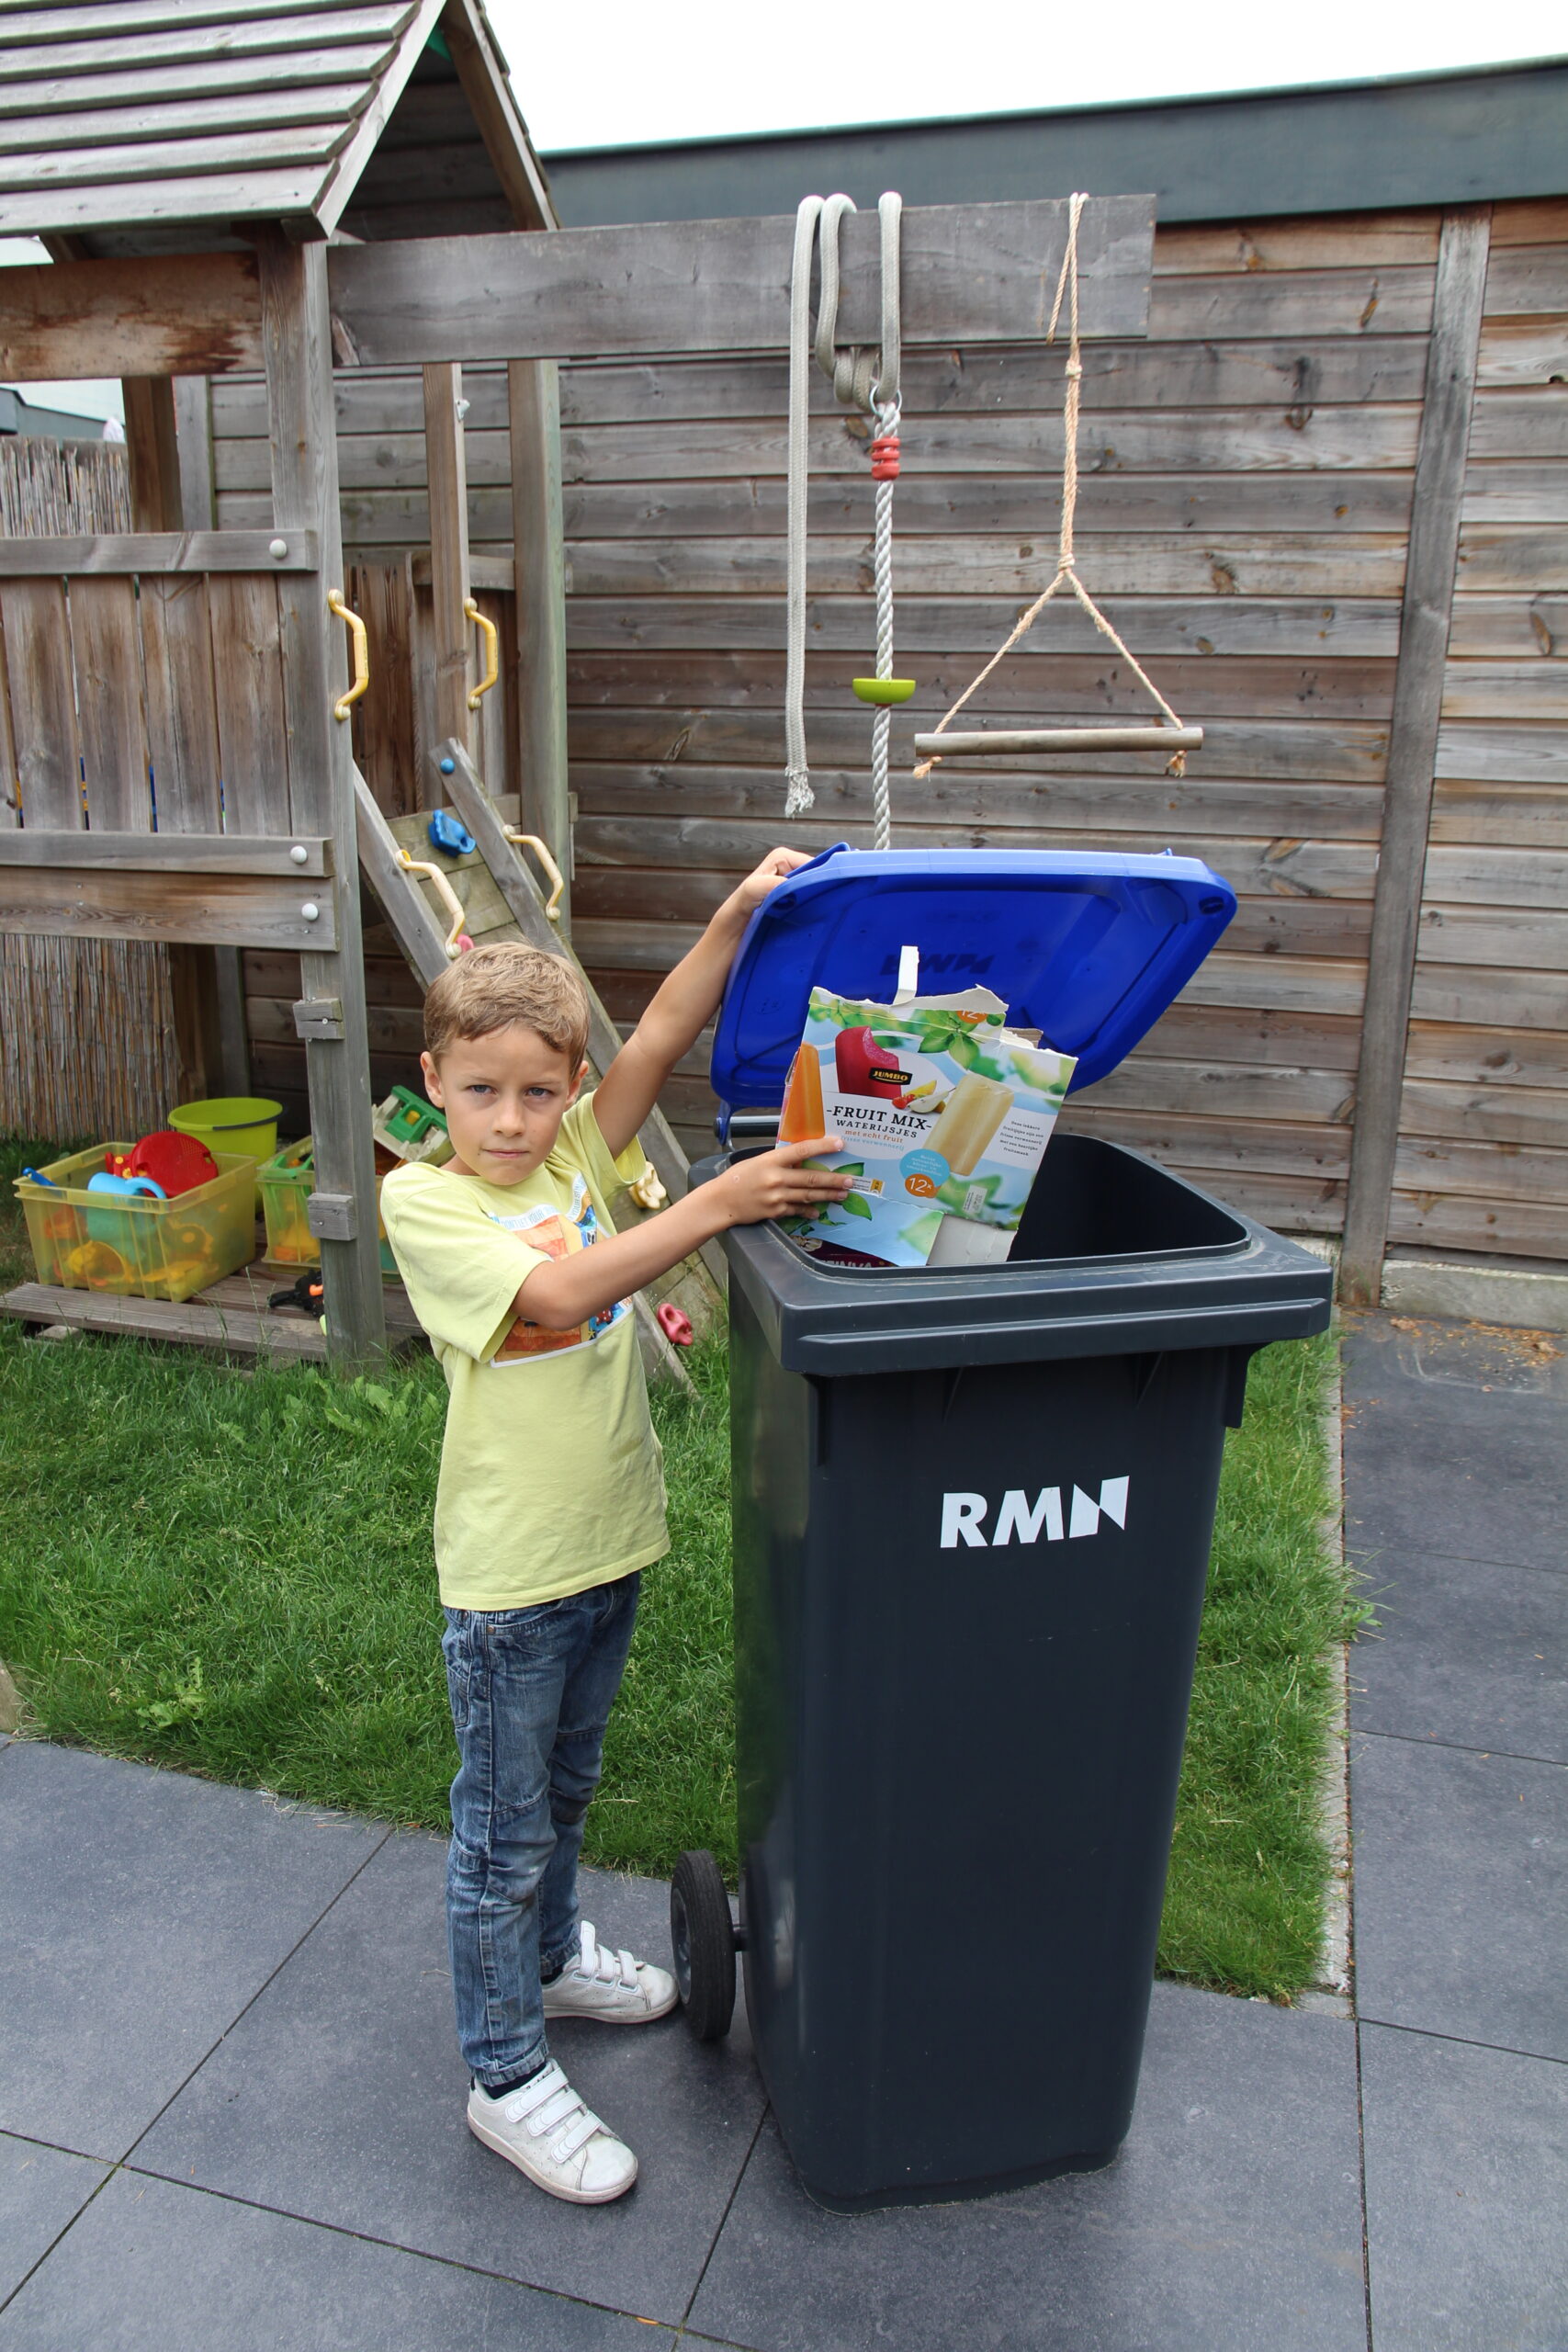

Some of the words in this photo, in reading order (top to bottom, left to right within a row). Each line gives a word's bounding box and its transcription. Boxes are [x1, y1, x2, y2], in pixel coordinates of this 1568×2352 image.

[873, 1070, 908, 1081] JUMBO
[836, 1119, 918, 1138] WATERIJSJES
[845, 1129, 861, 1137] met
[863, 1132, 882, 1140] echt
[883, 1135, 904, 1144] fruit
[940, 1475, 1130, 1549] RMN
